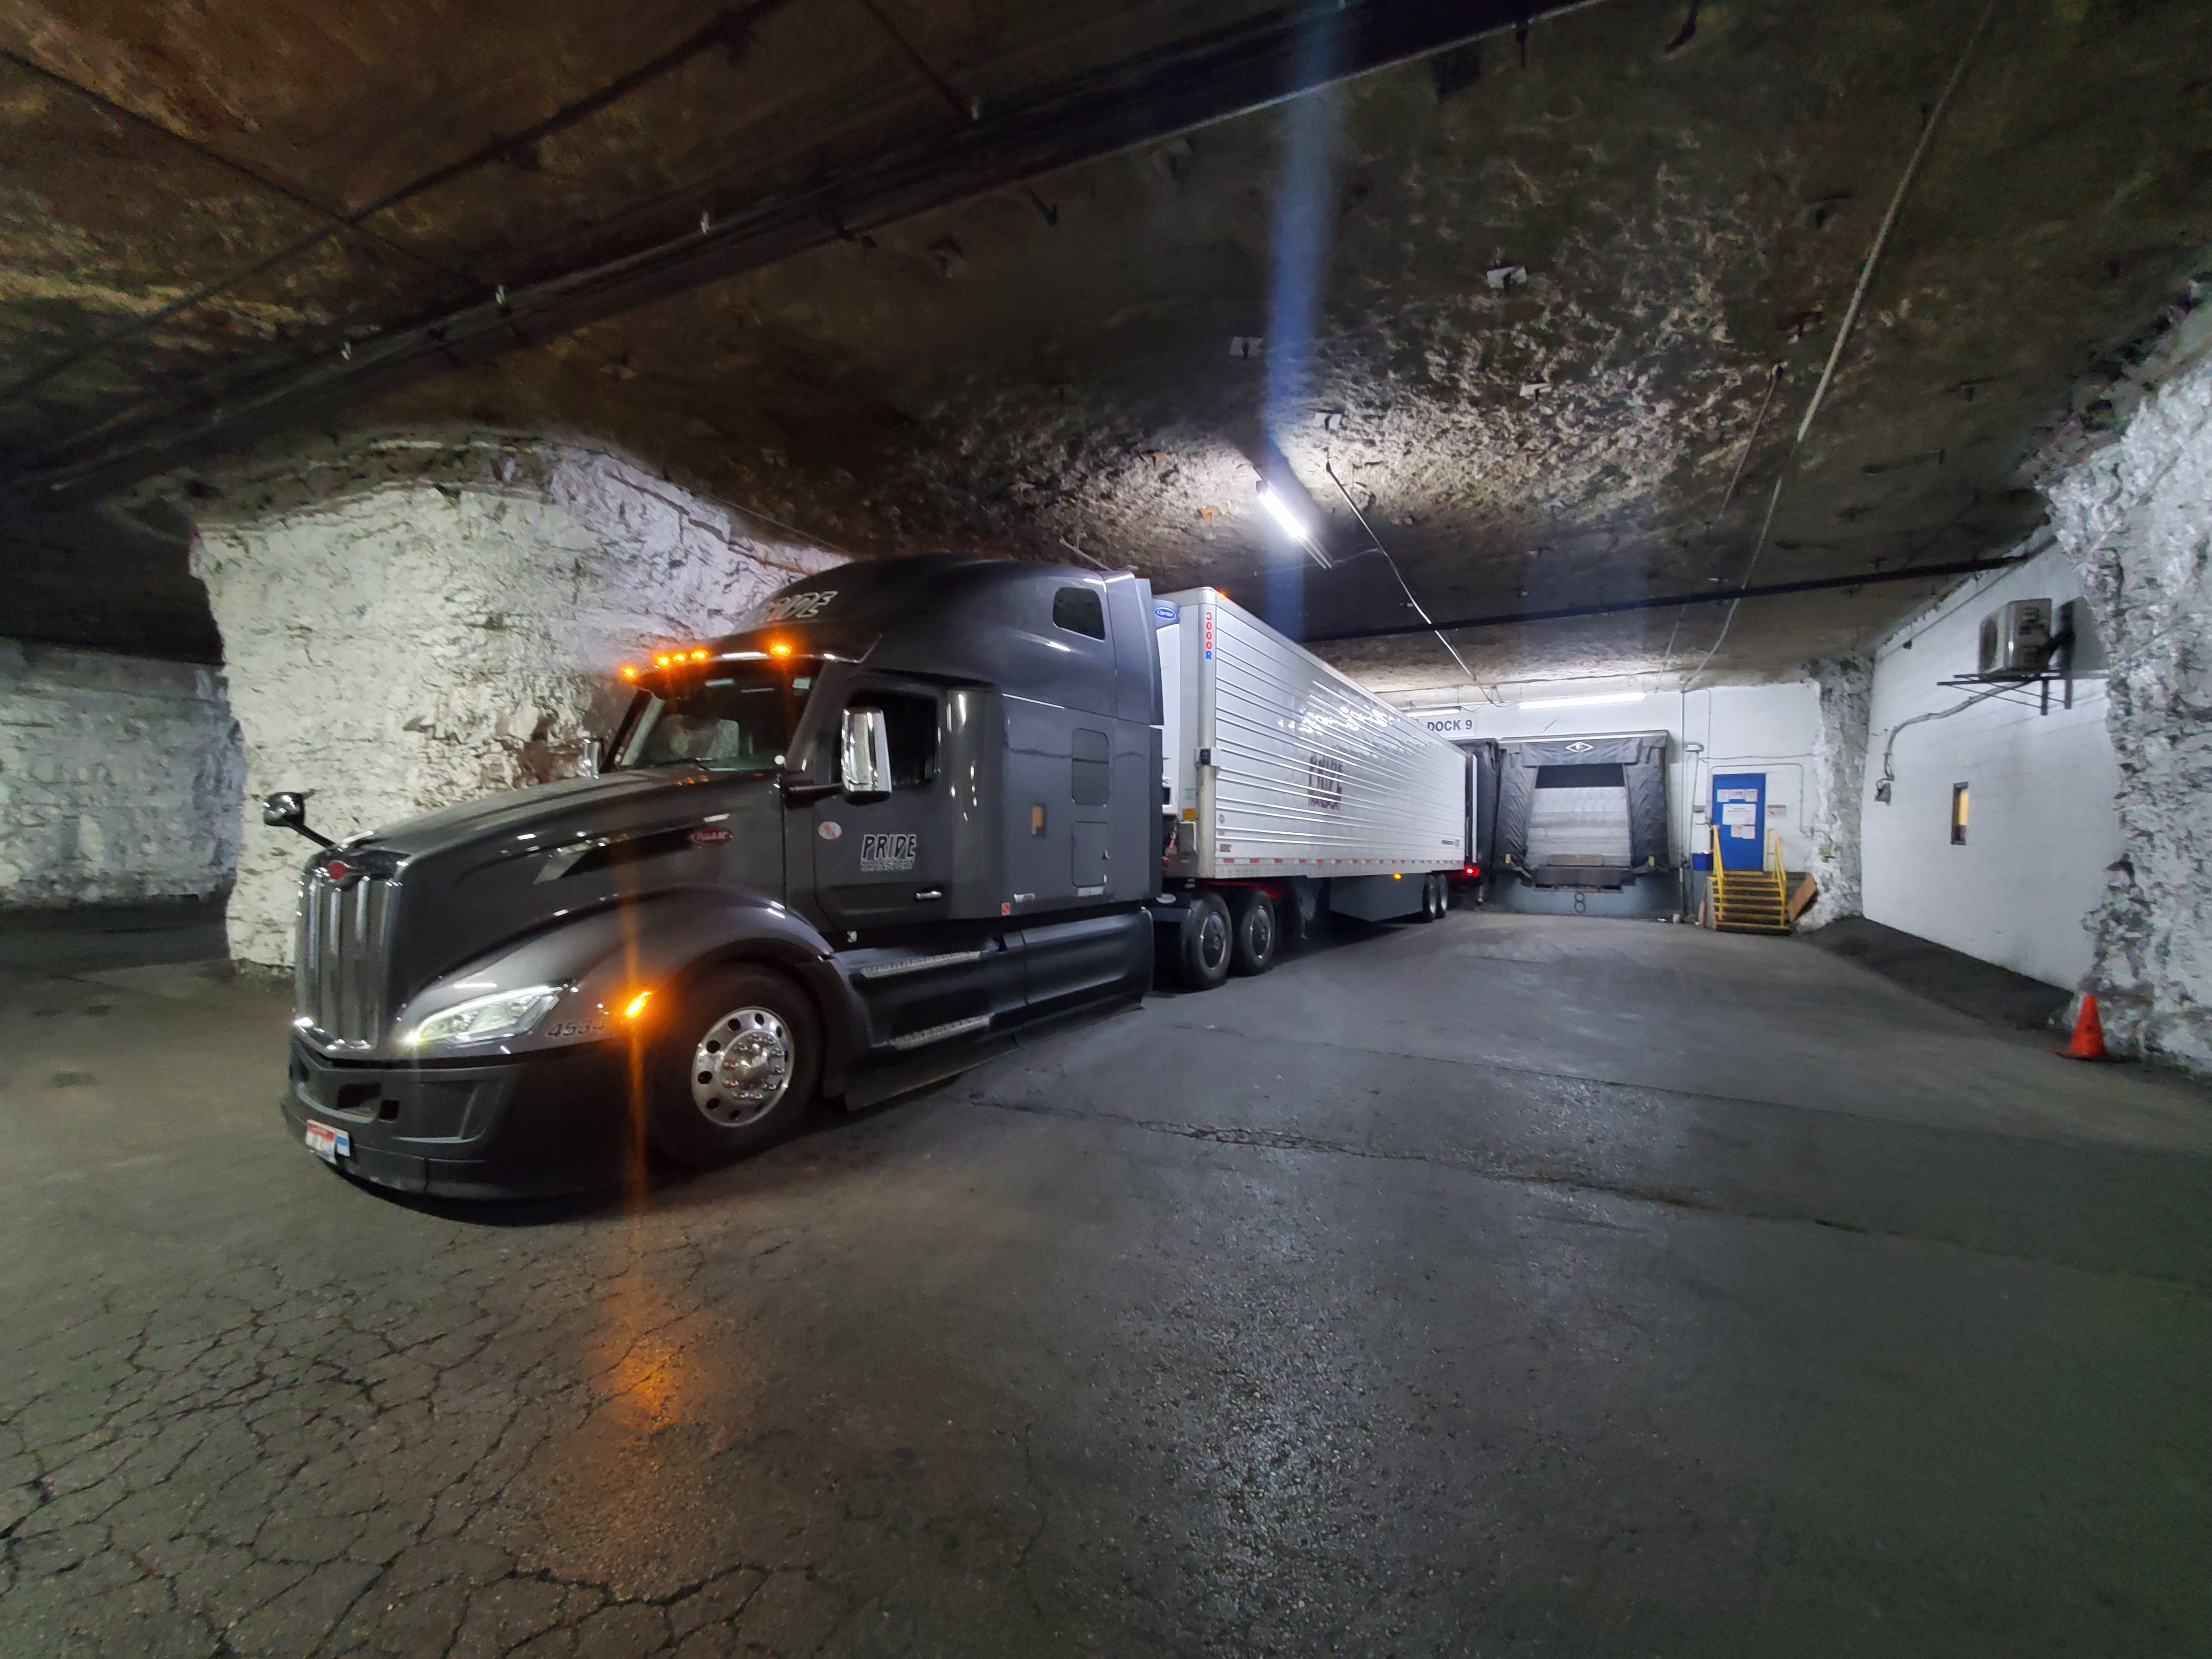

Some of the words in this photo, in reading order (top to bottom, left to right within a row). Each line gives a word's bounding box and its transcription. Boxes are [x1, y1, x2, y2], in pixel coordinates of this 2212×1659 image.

[1156, 609, 1174, 617] Carrier
[1427, 720, 1462, 732] DOCK
[1465, 719, 1472, 730] 9
[861, 834, 917, 859] PRIDE
[860, 858, 915, 871] TRANSPORT
[1574, 891, 1586, 913] 8
[545, 1019, 606, 1037] 4534
